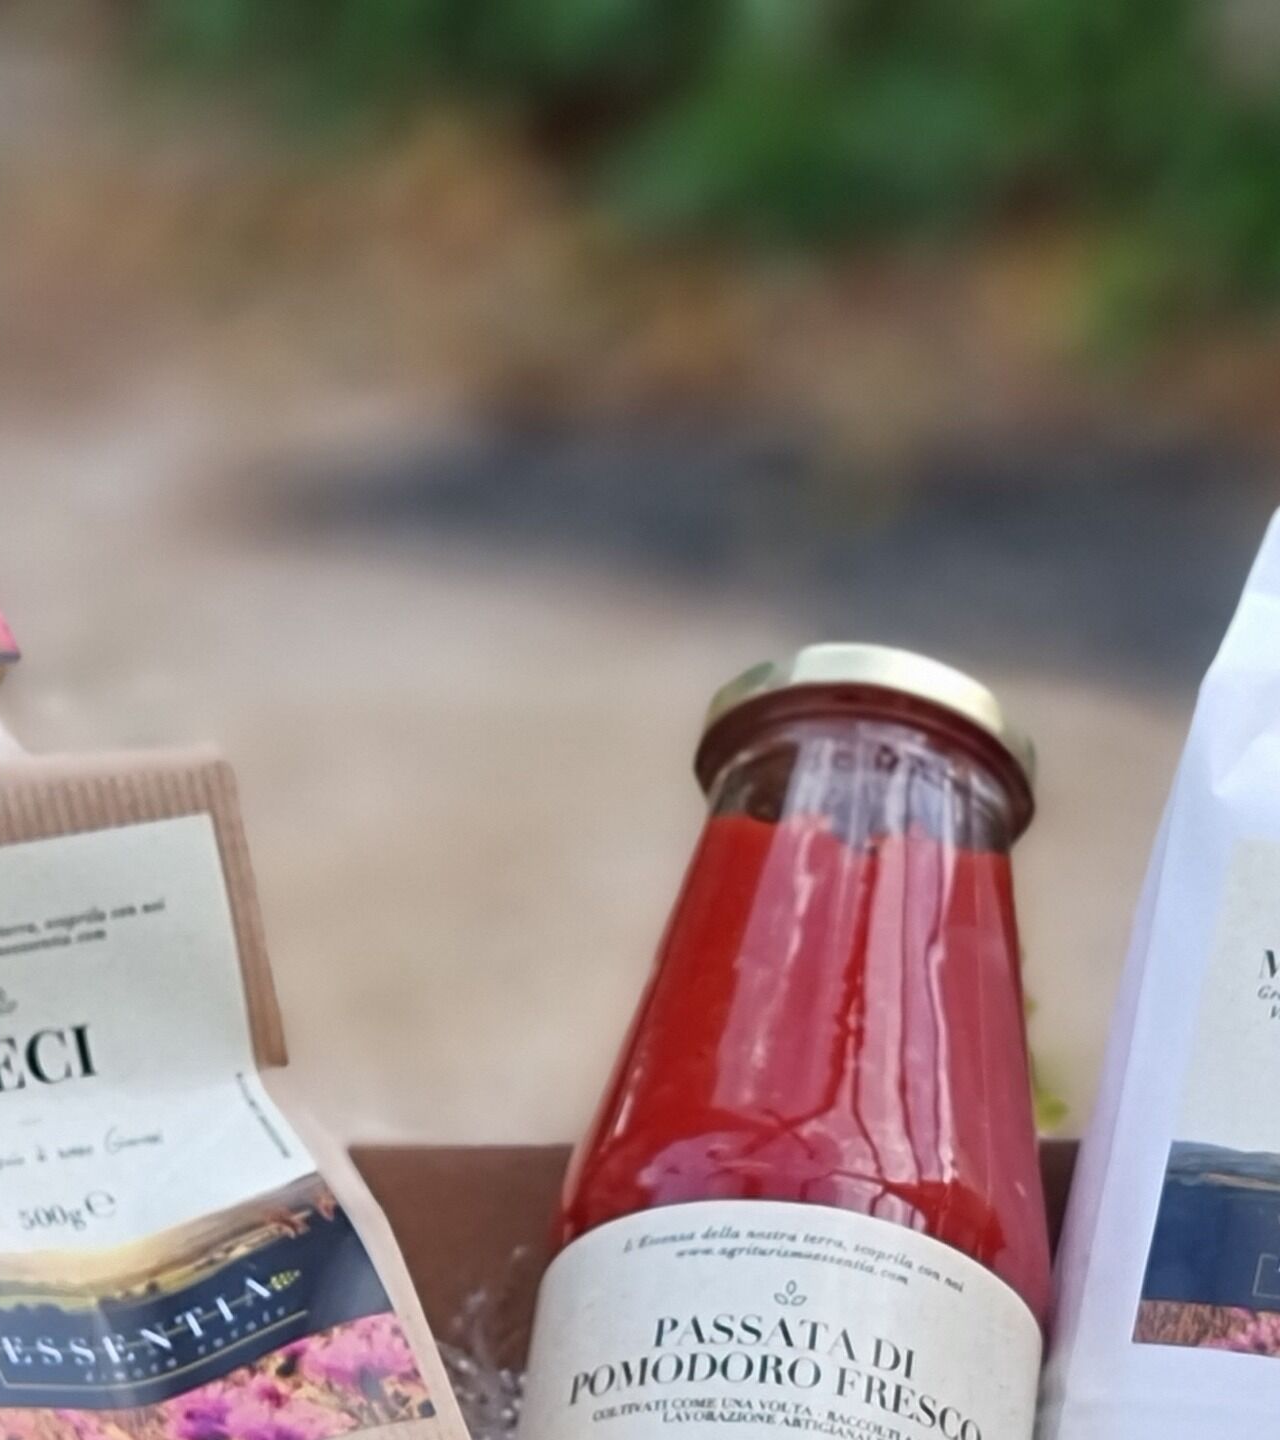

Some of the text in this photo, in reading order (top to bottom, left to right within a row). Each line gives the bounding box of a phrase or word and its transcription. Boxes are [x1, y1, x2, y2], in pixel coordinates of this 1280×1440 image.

[701, 1225, 740, 1240] della
[746, 1228, 797, 1243] nostra
[803, 1231, 848, 1251] terra,
[918, 1263, 941, 1281] con
[1, 1277, 272, 1365] ESSENTIA
[653, 1314, 916, 1380] PASSATA DI
[569, 1351, 822, 1407] POMODORO
[592, 1398, 671, 1422] COLTIVATI
[671, 1397, 717, 1411] COME
[721, 1399, 753, 1411] UNA
[756, 1400, 813, 1417] VOLTA
[662, 1410, 777, 1425] LAVORAZIONE
